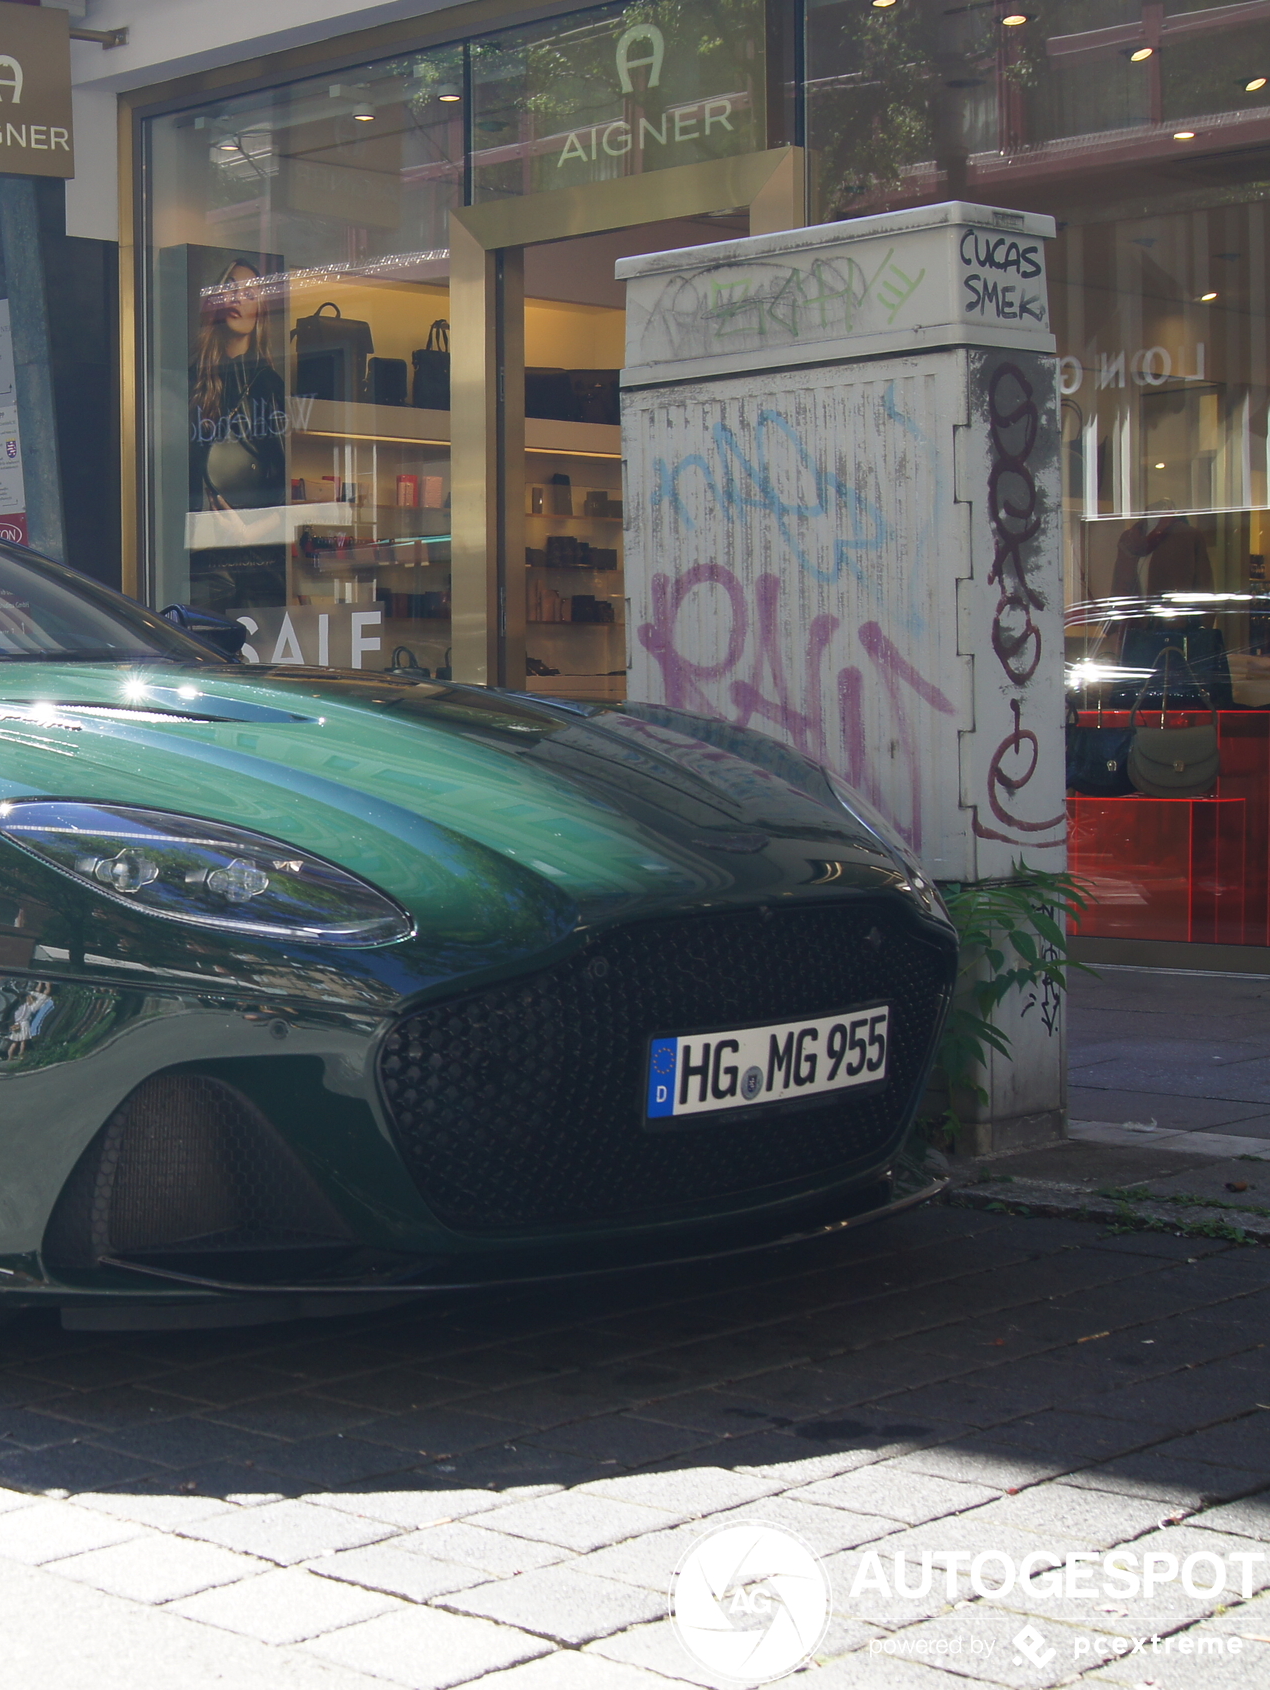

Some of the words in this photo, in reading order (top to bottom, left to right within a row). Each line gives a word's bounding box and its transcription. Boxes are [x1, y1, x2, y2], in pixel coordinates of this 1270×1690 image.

[557, 100, 734, 168] AIGNER
[656, 1085, 667, 1103] D
[679, 1039, 740, 1106] HG
[766, 1027, 819, 1092] MG
[827, 1014, 887, 1082] 955
